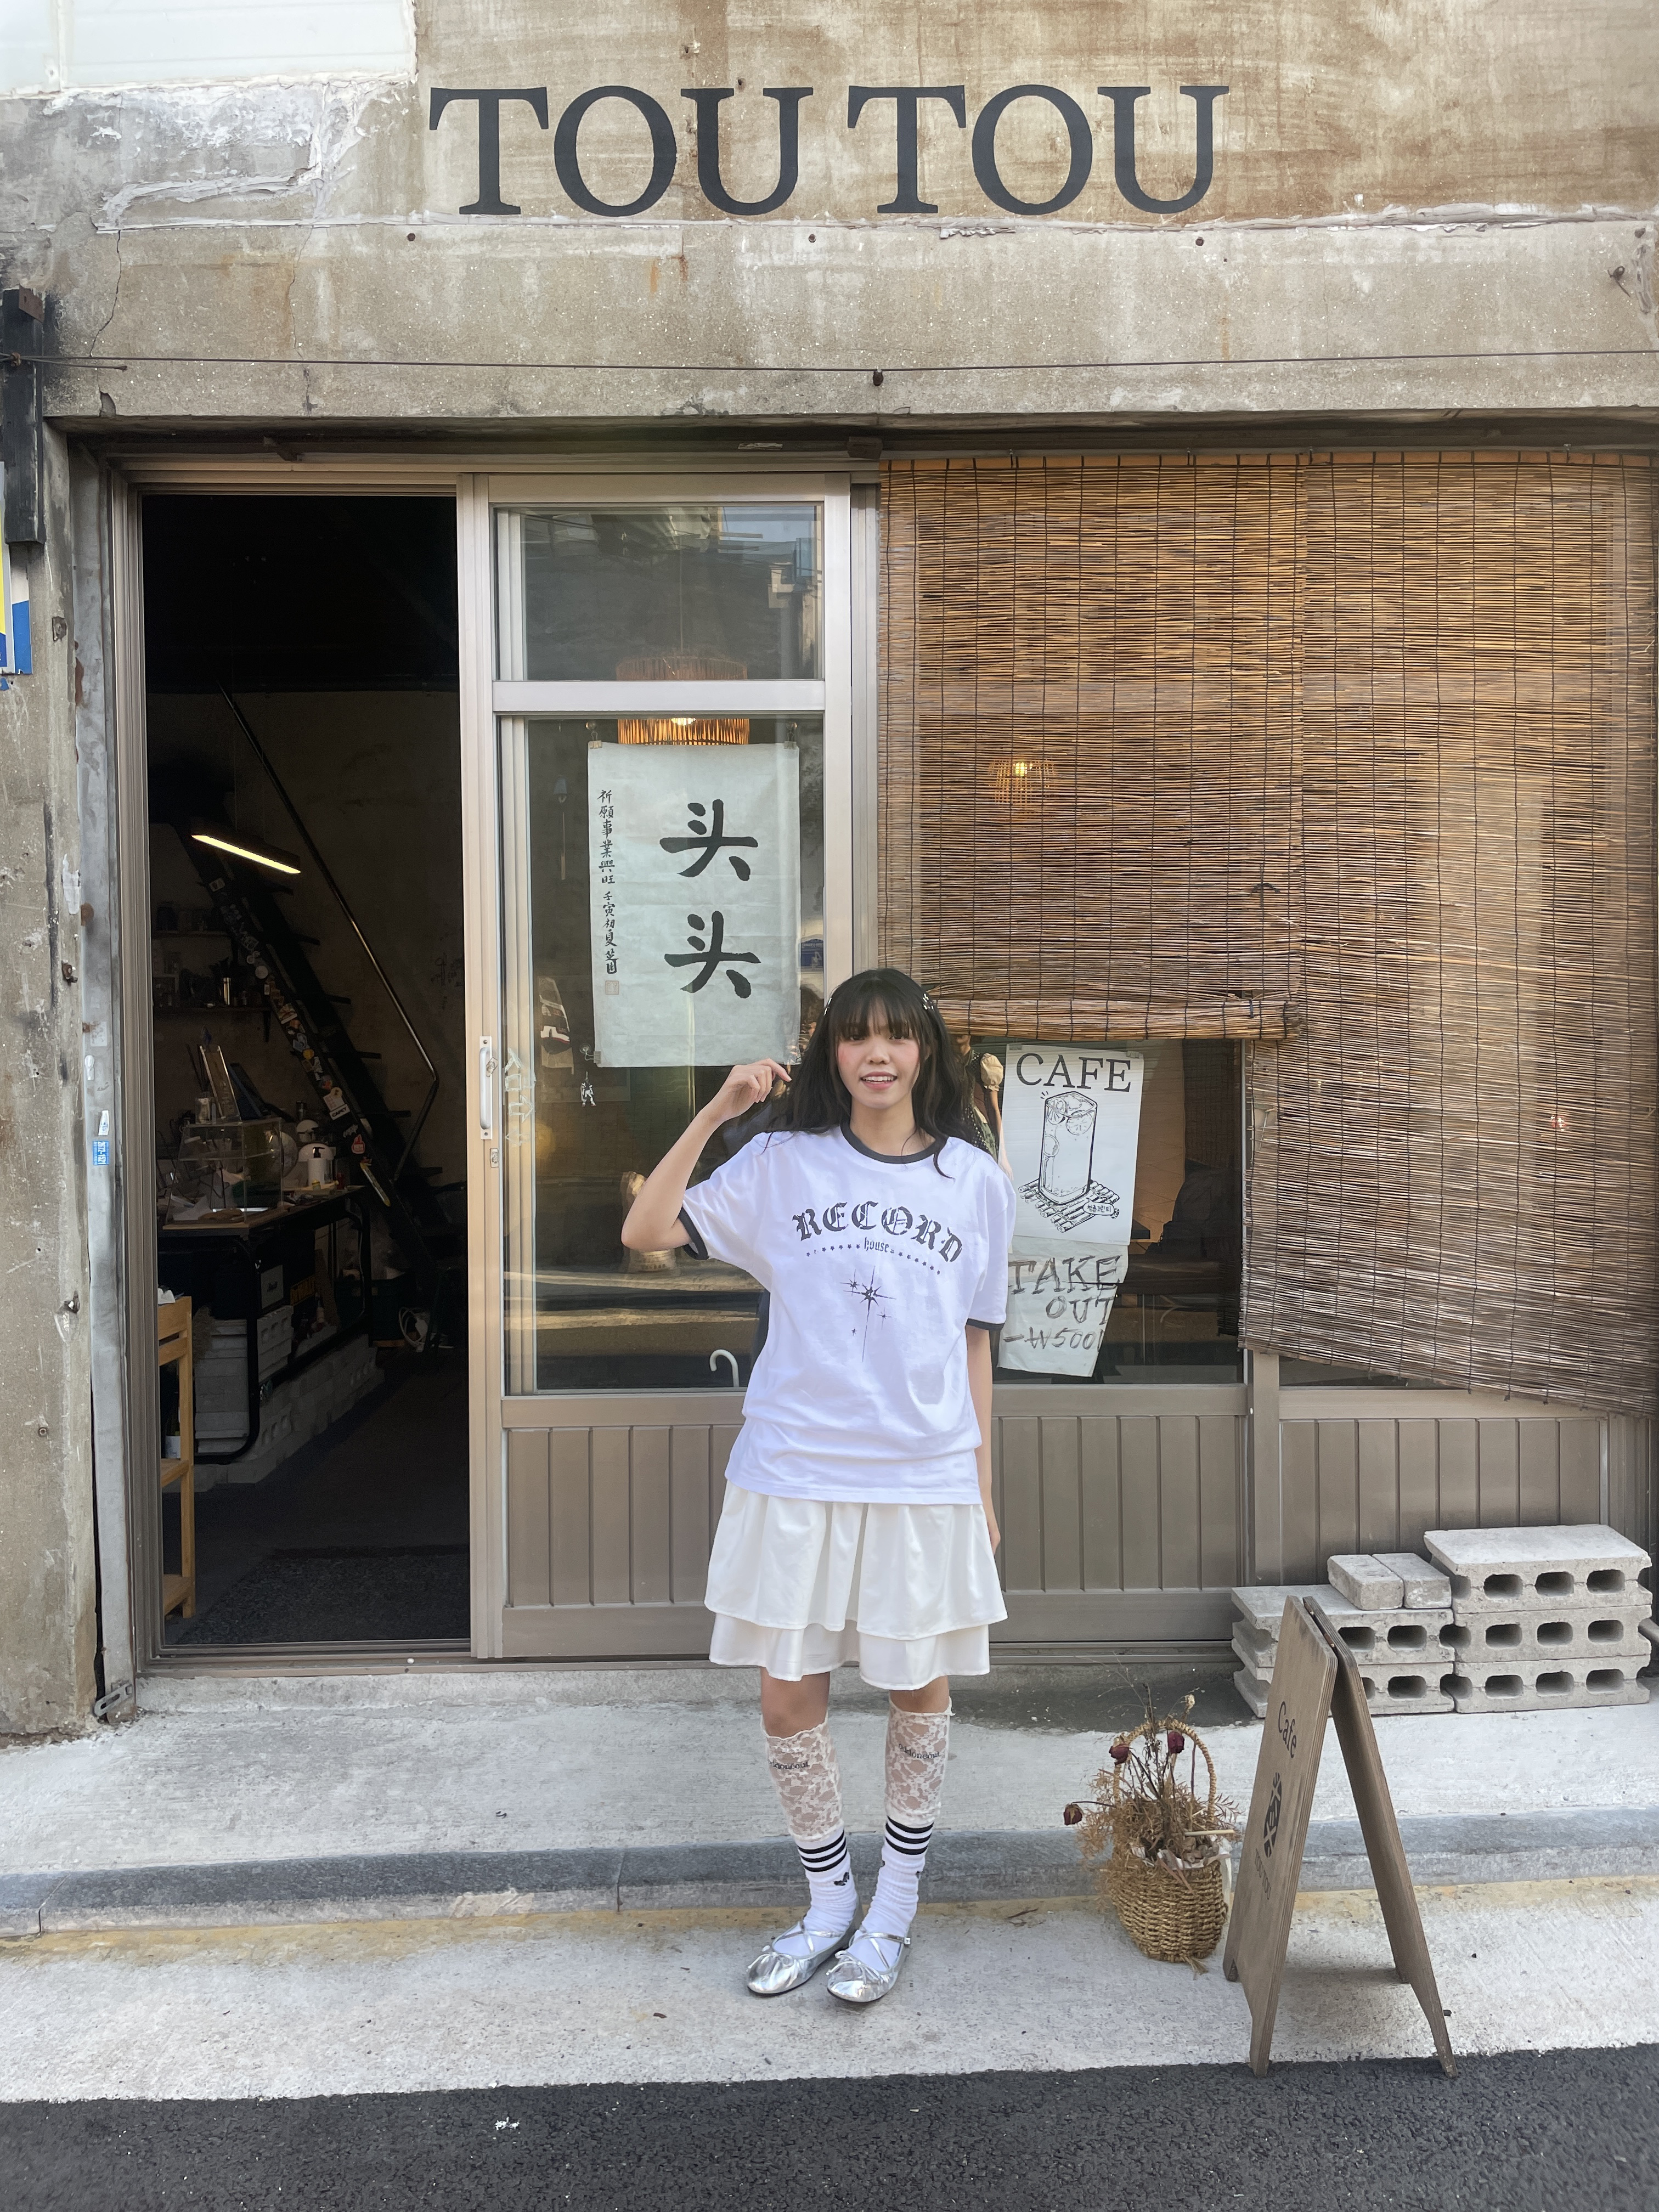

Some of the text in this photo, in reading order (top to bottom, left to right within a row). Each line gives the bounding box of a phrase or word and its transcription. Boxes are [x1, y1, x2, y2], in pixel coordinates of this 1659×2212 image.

[430, 84, 1229, 217] TOU TOU
[659, 799, 761, 999] 头头
[1016, 1053, 1131, 1092] CAFE
[792, 1200, 962, 1262] RECORD
[864, 1237, 889, 1252] house
[1008, 1255, 1122, 1295] TAKE
[1045, 1296, 1115, 1325] OUT
[1278, 1701, 1297, 1759] Cafe
